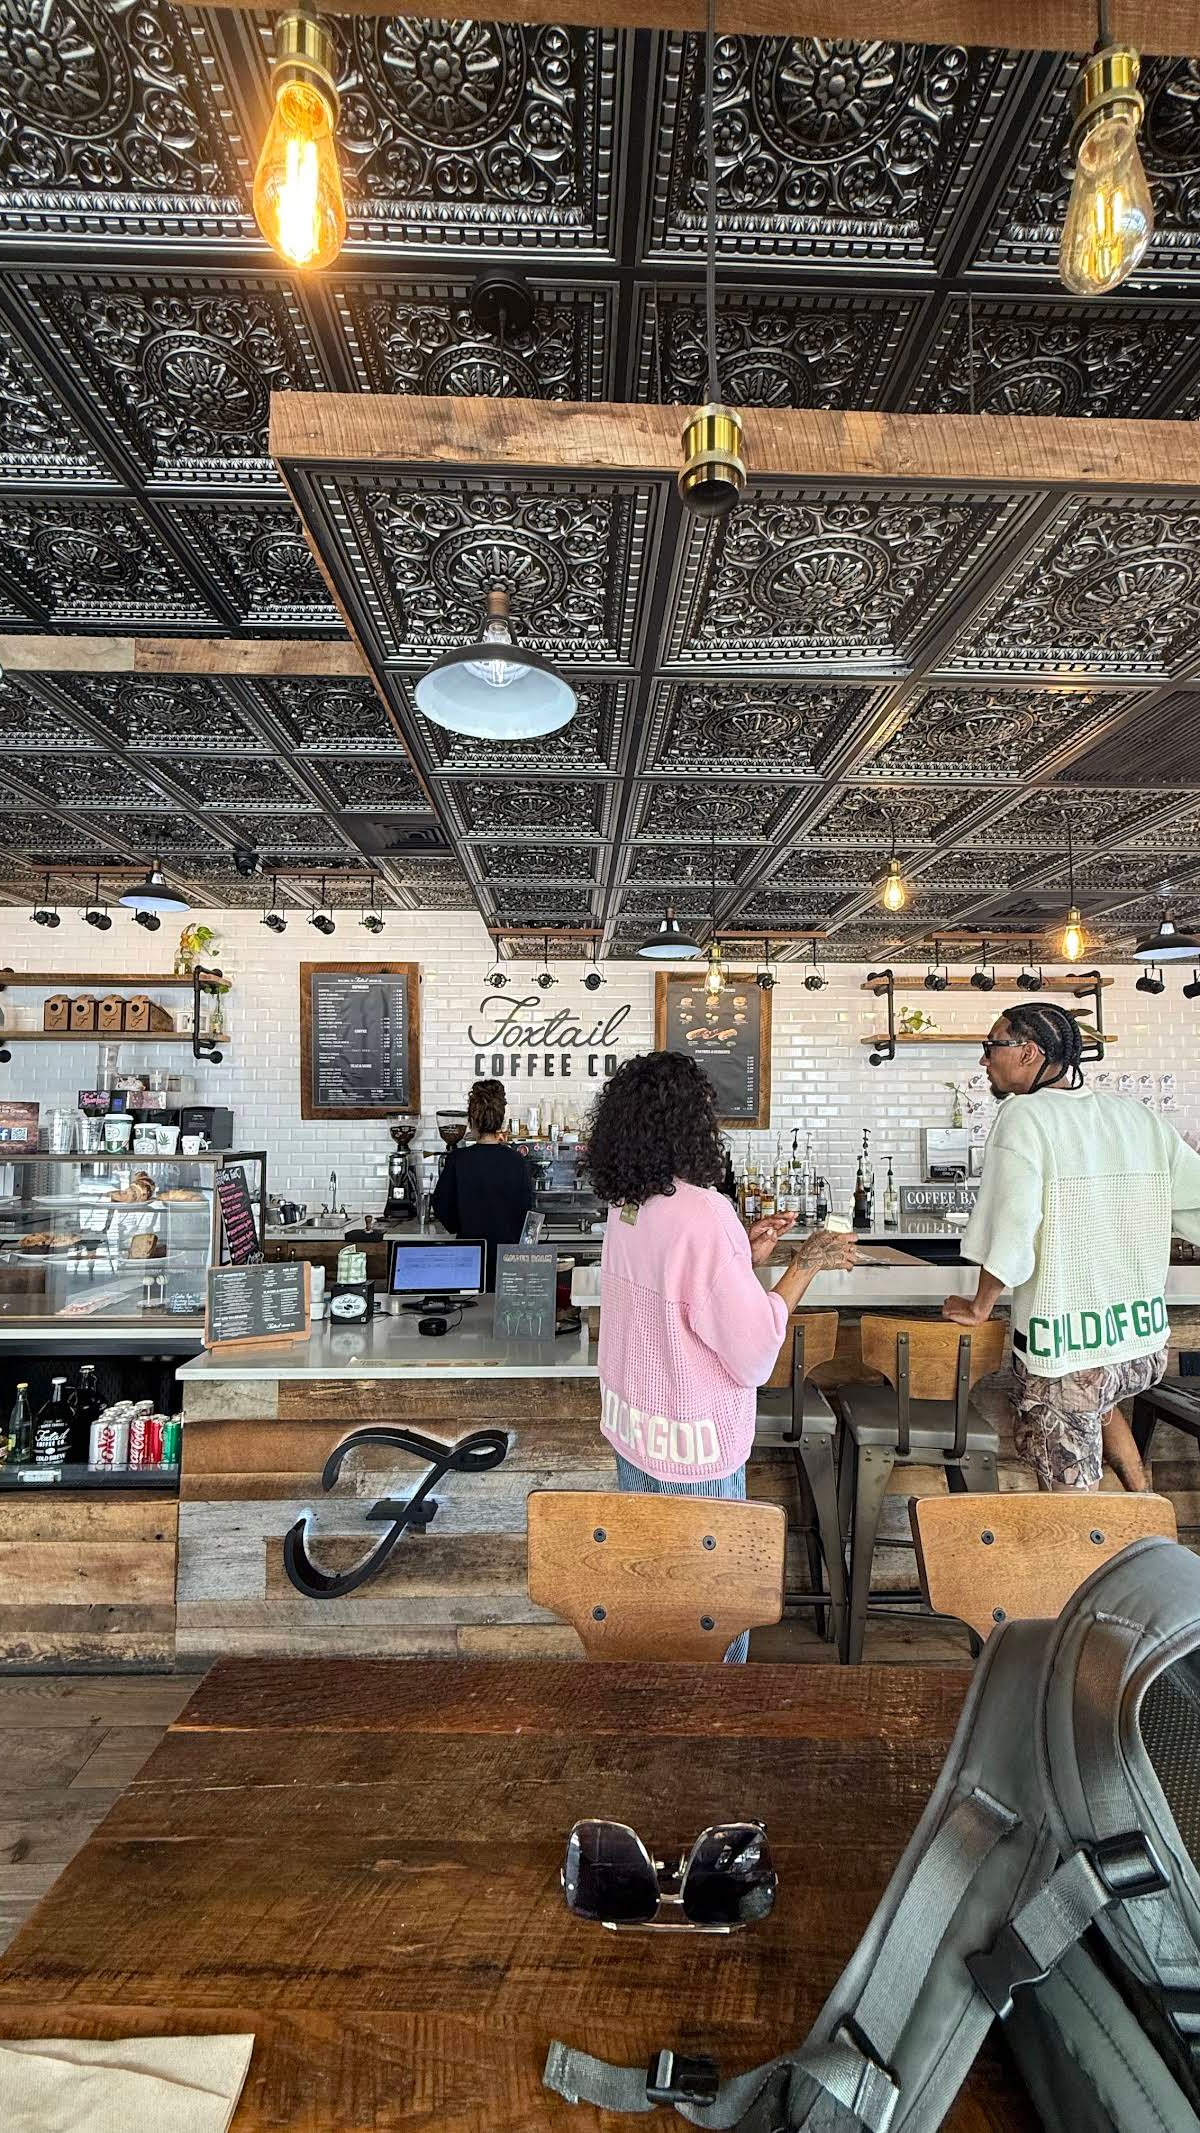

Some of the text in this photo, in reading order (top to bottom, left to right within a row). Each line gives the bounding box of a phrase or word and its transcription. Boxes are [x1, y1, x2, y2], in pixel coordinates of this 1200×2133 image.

[468, 995, 631, 1047] Foxtail
[475, 1053, 571, 1077] COFFEE
[907, 1191, 977, 1204] COFFEE BA
[1105, 1303, 1128, 1347] OF
[1131, 1296, 1168, 1337] GO
[35, 1428, 70, 1442] Foxtail
[646, 1414, 721, 1466] GOD
